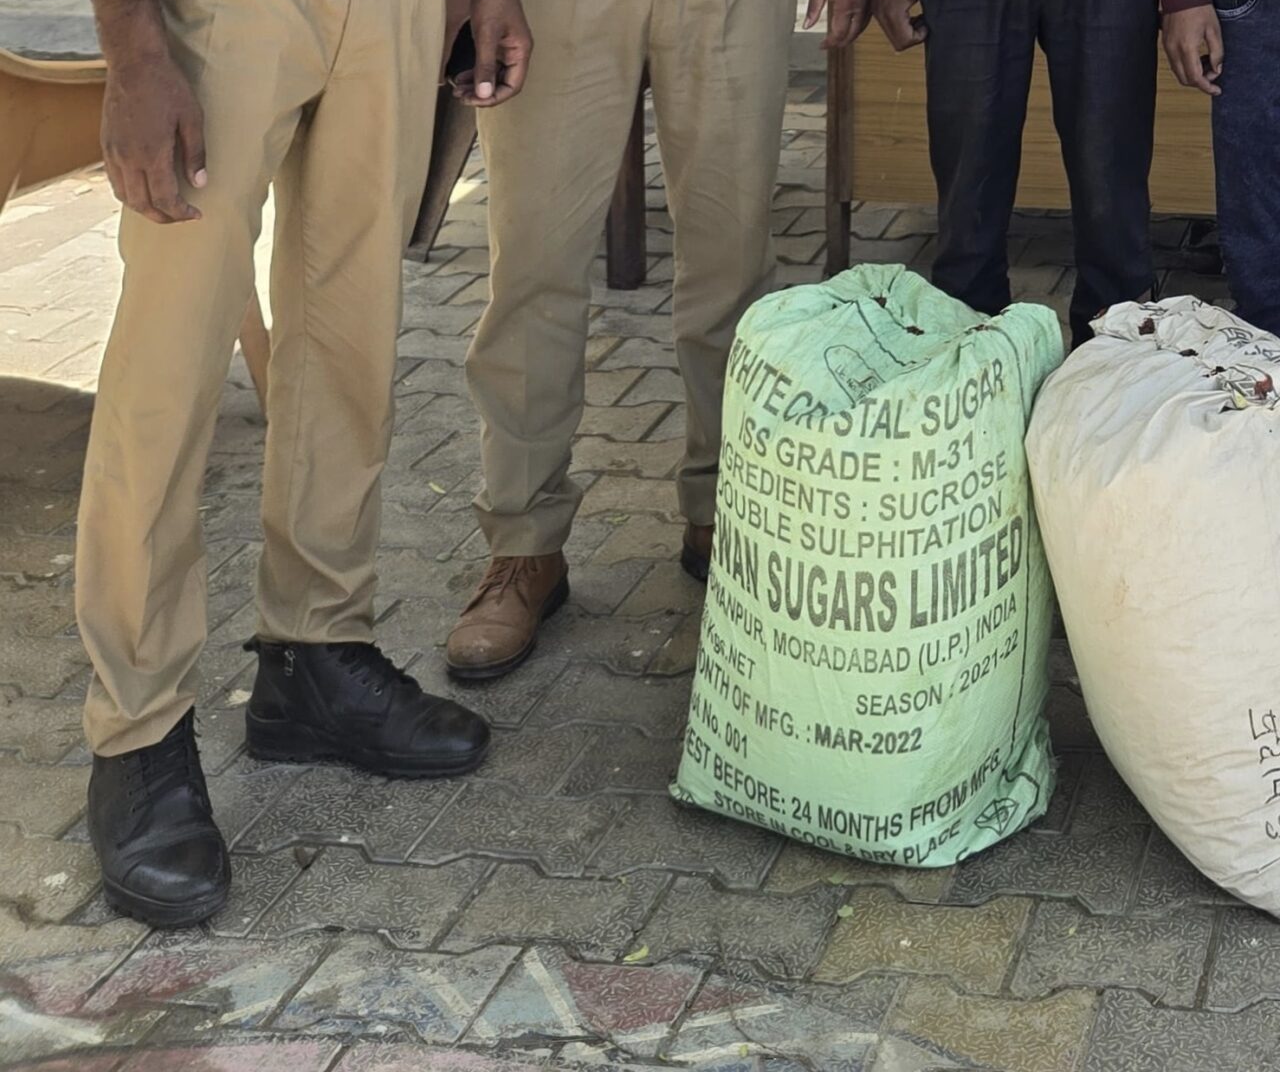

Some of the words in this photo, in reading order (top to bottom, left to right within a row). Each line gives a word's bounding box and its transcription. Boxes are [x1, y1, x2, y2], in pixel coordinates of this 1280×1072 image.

[730, 338, 793, 416] WHITE
[921, 358, 1004, 436] SUGAR
[739, 411, 771, 457] ISS
[776, 437, 881, 482] GRADE
[912, 430, 974, 480] M-31
[879, 450, 1008, 521] SUCROSE
[800, 490, 1002, 559] SULPHITATION
[767, 550, 897, 632] SUGARS
[911, 515, 1023, 629] LIMITED
[773, 628, 911, 674] MORADABAD
[919, 626, 970, 675] (U.P.)
[976, 592, 1017, 643] INDIA
[856, 683, 943, 716] SEASON
[959, 629, 1019, 693] 2021-22
[699, 647, 730, 700] ONTH
[732, 684, 751, 716] OF
[755, 701, 799, 739] MFG.
[815, 723, 922, 754] MAR-2022
[725, 721, 747, 759] 001
[687, 727, 711, 769] EST
[714, 753, 786, 815] BEFORE:
[791, 796, 812, 824] 24
[818, 805, 902, 842] MONTHS
[910, 780, 967, 831] FROM
[714, 790, 766, 824] STORE
[791, 827, 841, 851] COOL
[860, 848, 897, 862] DRY
[903, 819, 962, 864] PLACE
